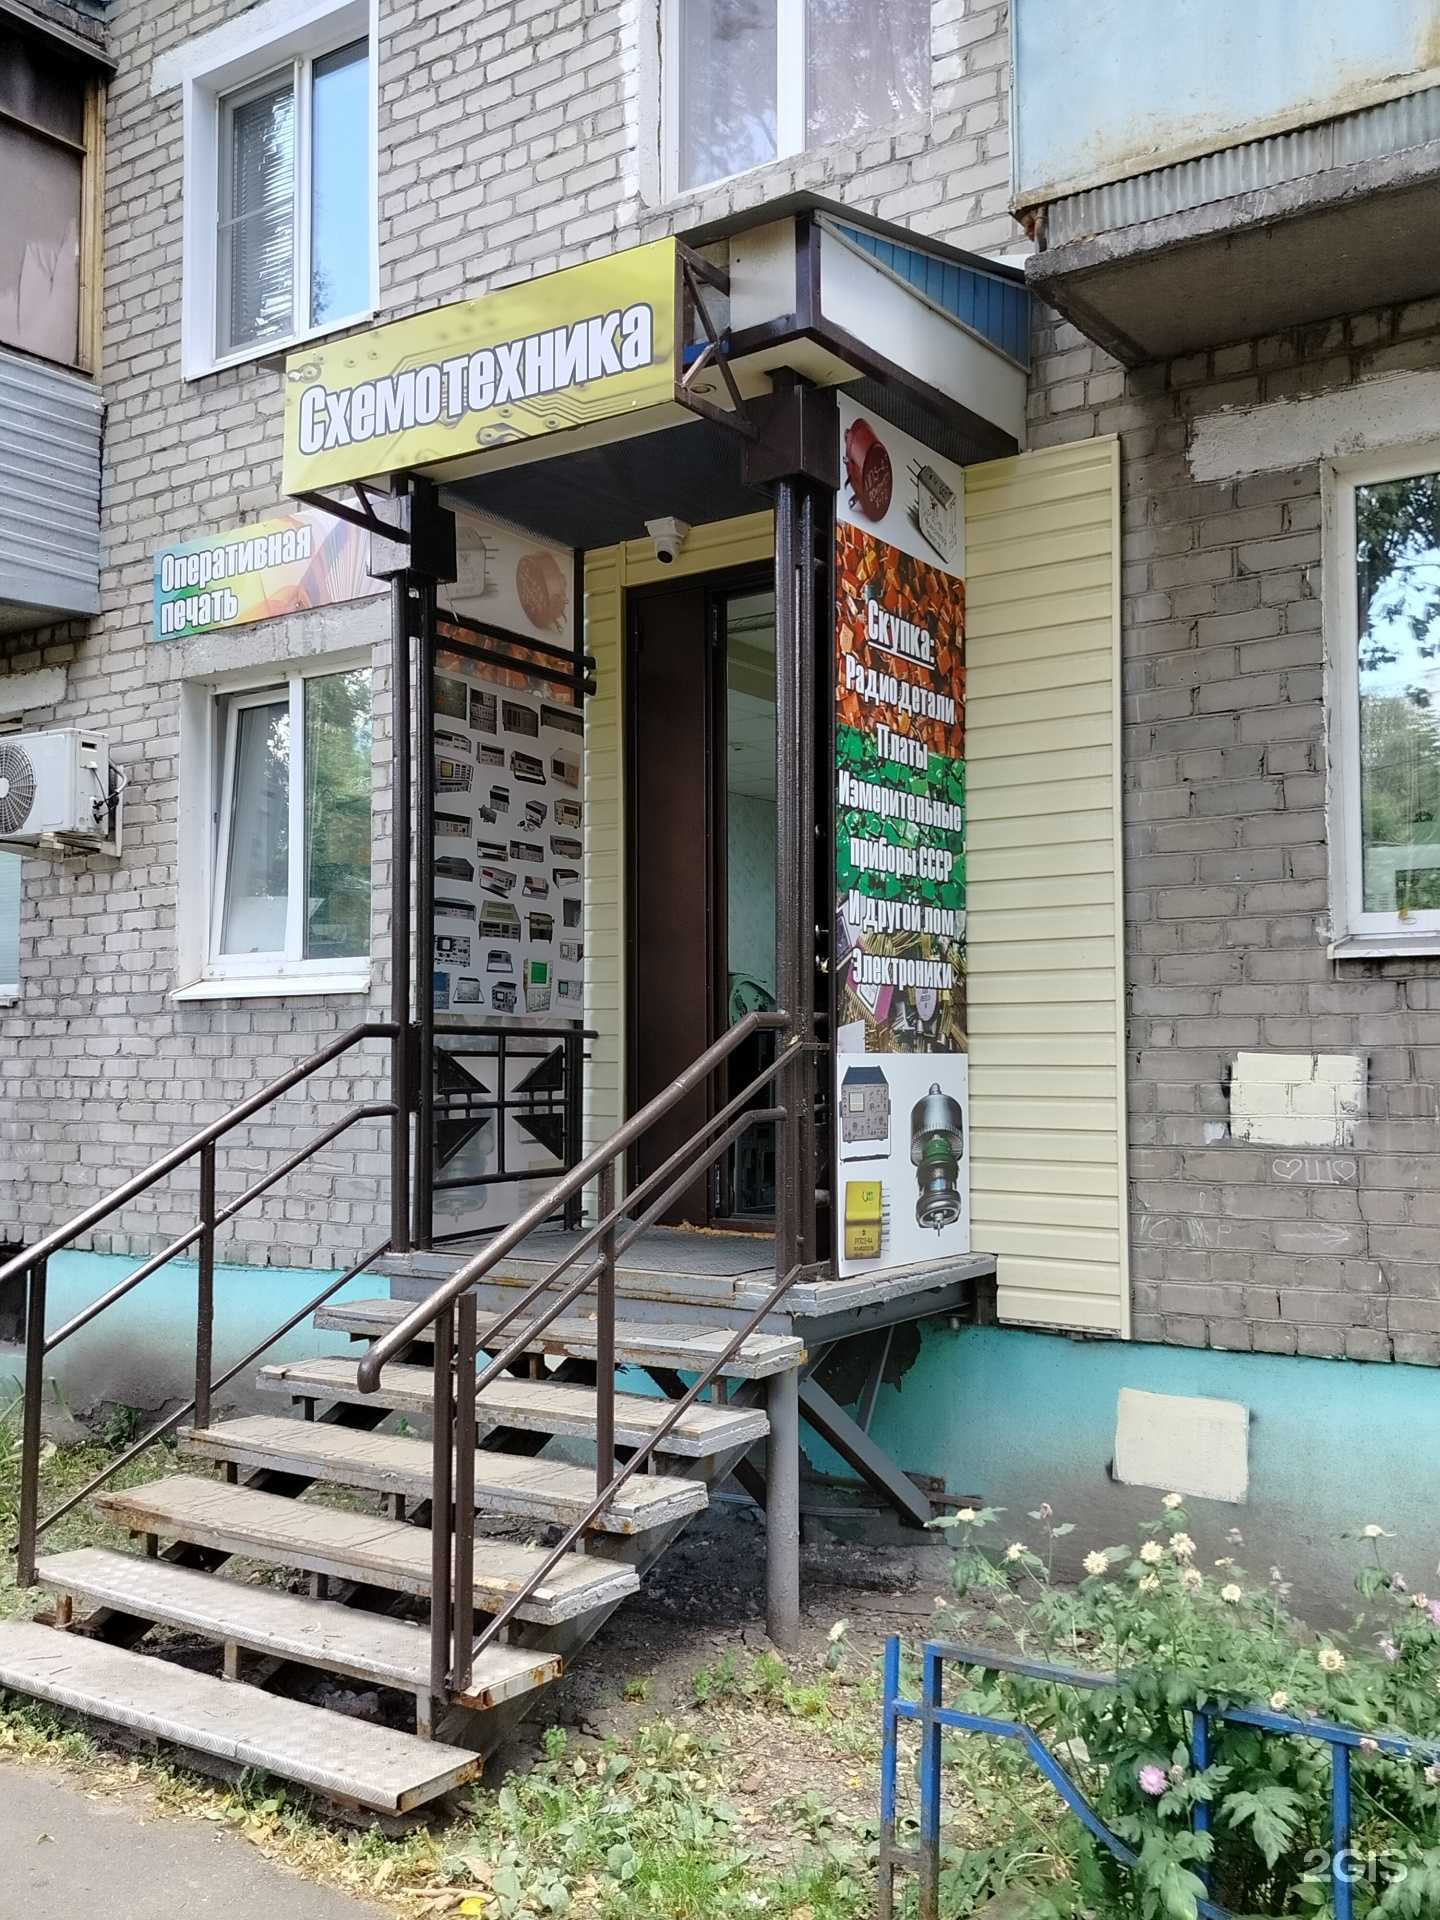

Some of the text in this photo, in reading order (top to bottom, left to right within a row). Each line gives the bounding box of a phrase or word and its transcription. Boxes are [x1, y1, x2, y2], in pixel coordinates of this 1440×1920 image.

[299, 303, 654, 456] Схемотехника
[160, 524, 313, 593] Оперативная
[160, 587, 239, 635] печать
[867, 599, 935, 663] Скупка:
[845, 654, 955, 725] Радиодетали
[876, 723, 929, 770] Платы
[838, 769, 962, 832] Измерительные
[850, 837, 953, 882] приборы СССР
[849, 888, 954, 937] И другой лом
[851, 947, 953, 991] Электроники
